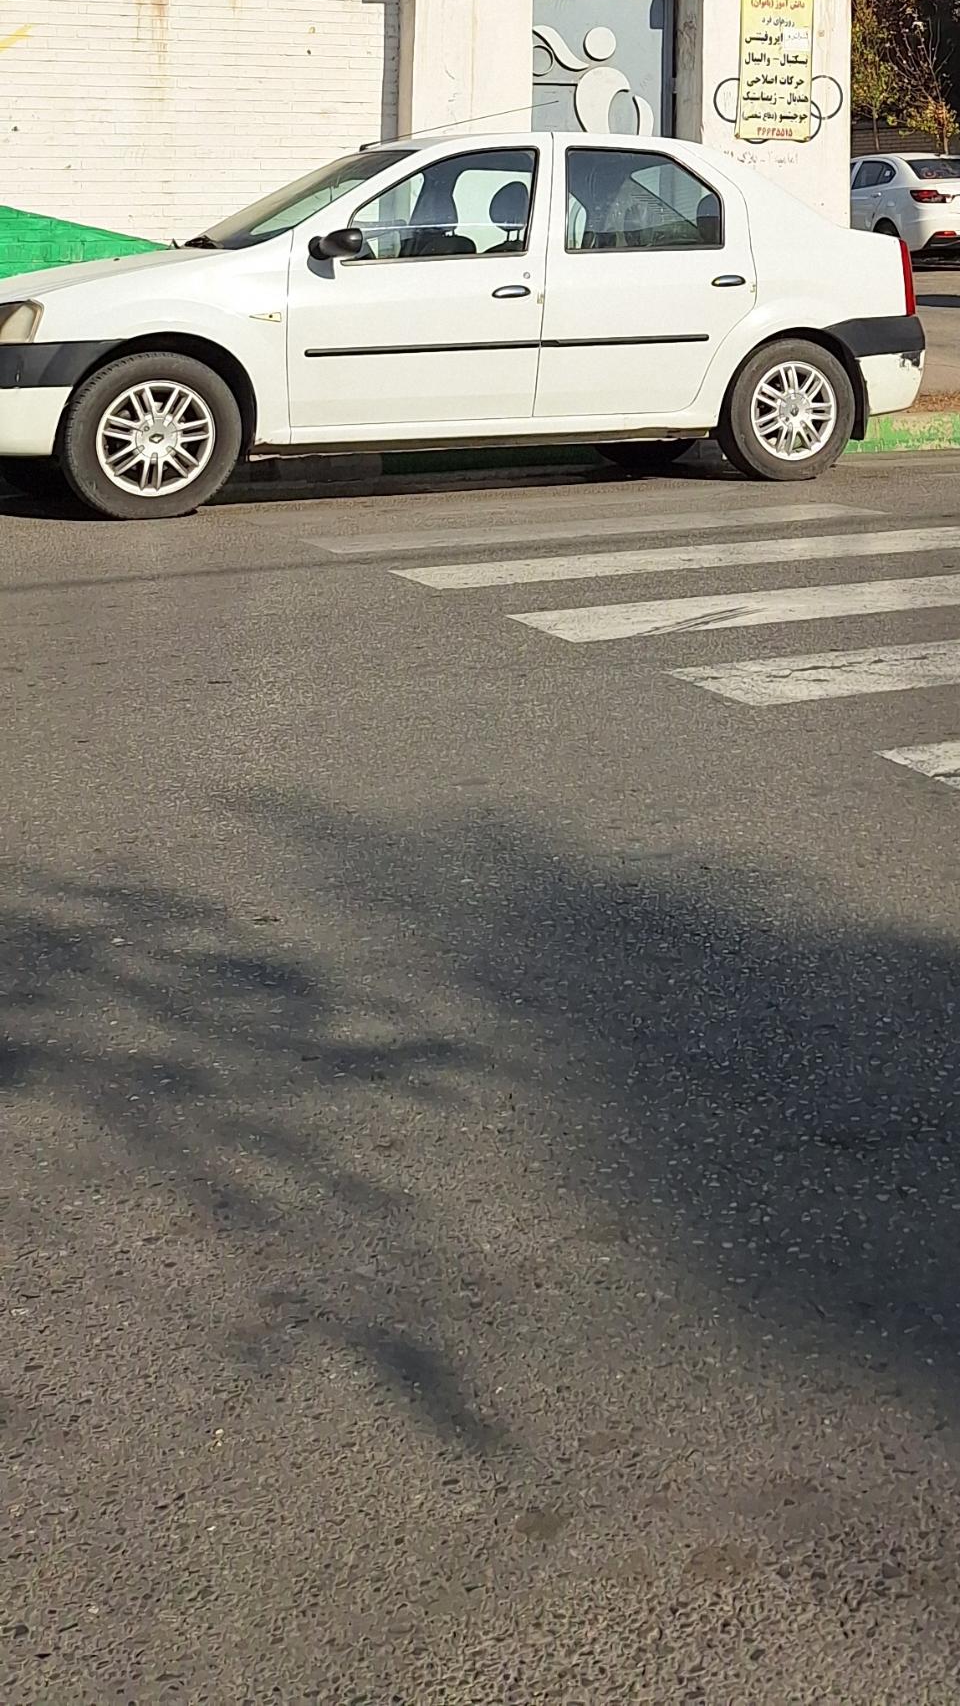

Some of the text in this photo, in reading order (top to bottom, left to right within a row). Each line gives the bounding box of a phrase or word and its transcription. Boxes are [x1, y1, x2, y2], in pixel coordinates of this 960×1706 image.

[775, 0, 788, 9] آموز
[790, 0, 805, 10] دانش
[745, 52, 770, 66] والیبال
[747, 74, 804, 89] حرکات اصلاحی
[787, 92, 809, 105] هندبال
[757, 127, 793, 136] ۳۶۶۳۵۵۱۵
